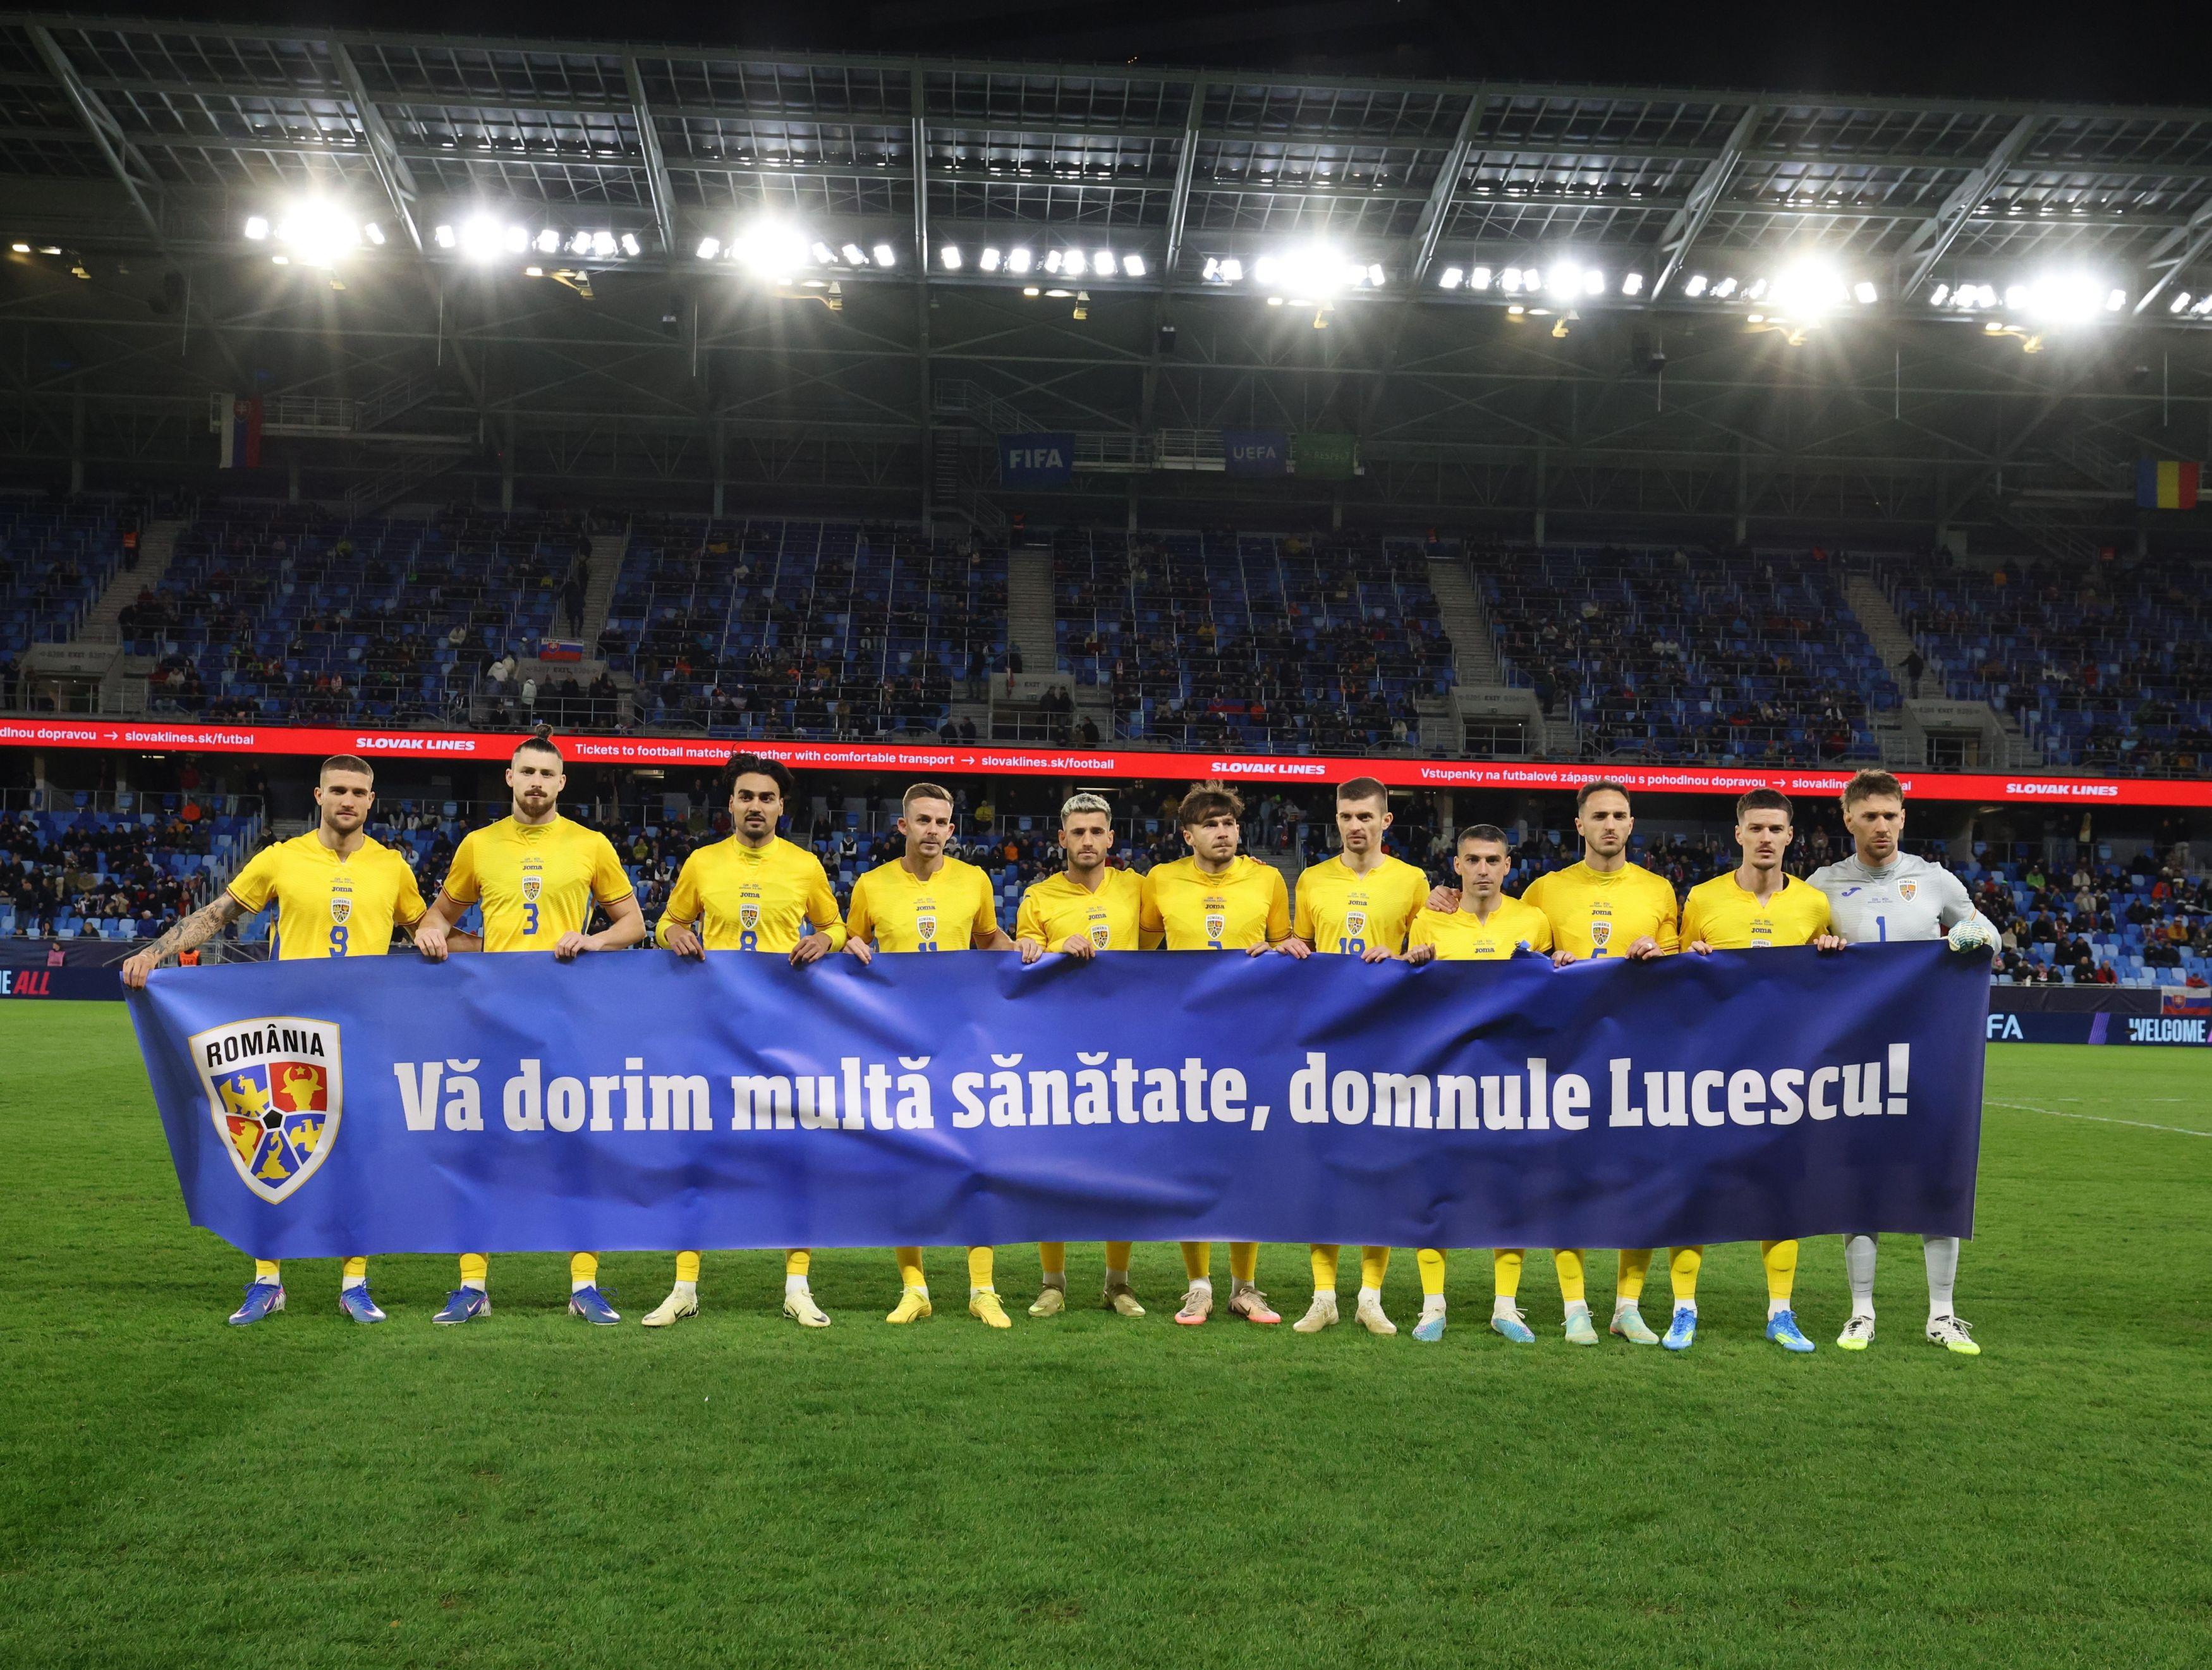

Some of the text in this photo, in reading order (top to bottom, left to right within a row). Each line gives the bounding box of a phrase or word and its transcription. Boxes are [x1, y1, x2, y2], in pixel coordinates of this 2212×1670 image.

[1010, 449, 1063, 468] FIFA
[1233, 446, 1276, 460] UEFA
[0, 727, 254, 745] dlnou dopravou slovaklines.sk/futbal
[356, 738, 475, 751] SLOVAK LINES
[575, 743, 619, 755] Tickets
[623, 746, 635, 756] to
[637, 745, 683, 757] football
[795, 750, 821, 761] with
[823, 751, 896, 763] comfortable
[899, 754, 954, 767] transport
[981, 756, 1114, 769] slovaklines.sk/football
[1211, 762, 1325, 775] SLOVAK LINES
[1421, 769, 1484, 782] Vstupenky
[1486, 772, 1500, 780] na
[1503, 770, 1558, 782] futbalové
[1560, 771, 1601, 784] zápasy
[1604, 773, 1636, 784] spolu
[1638, 776, 1645, 784] s
[1648, 774, 1709, 786] pohodlnou
[1711, 776, 1766, 789] dopravou
[2006, 783, 2118, 796] SLOVAK LINES
[523, 903, 538, 935] 3
[329, 926, 348, 957] 9
[13, 971, 51, 995] ALL
[2128, 1018, 2206, 1043] WELCOME
[206, 1023, 325, 1068] ROMÂNIA
[394, 1043, 1910, 1132] Vă dorim multă sănătate, domnule Lucescu!
